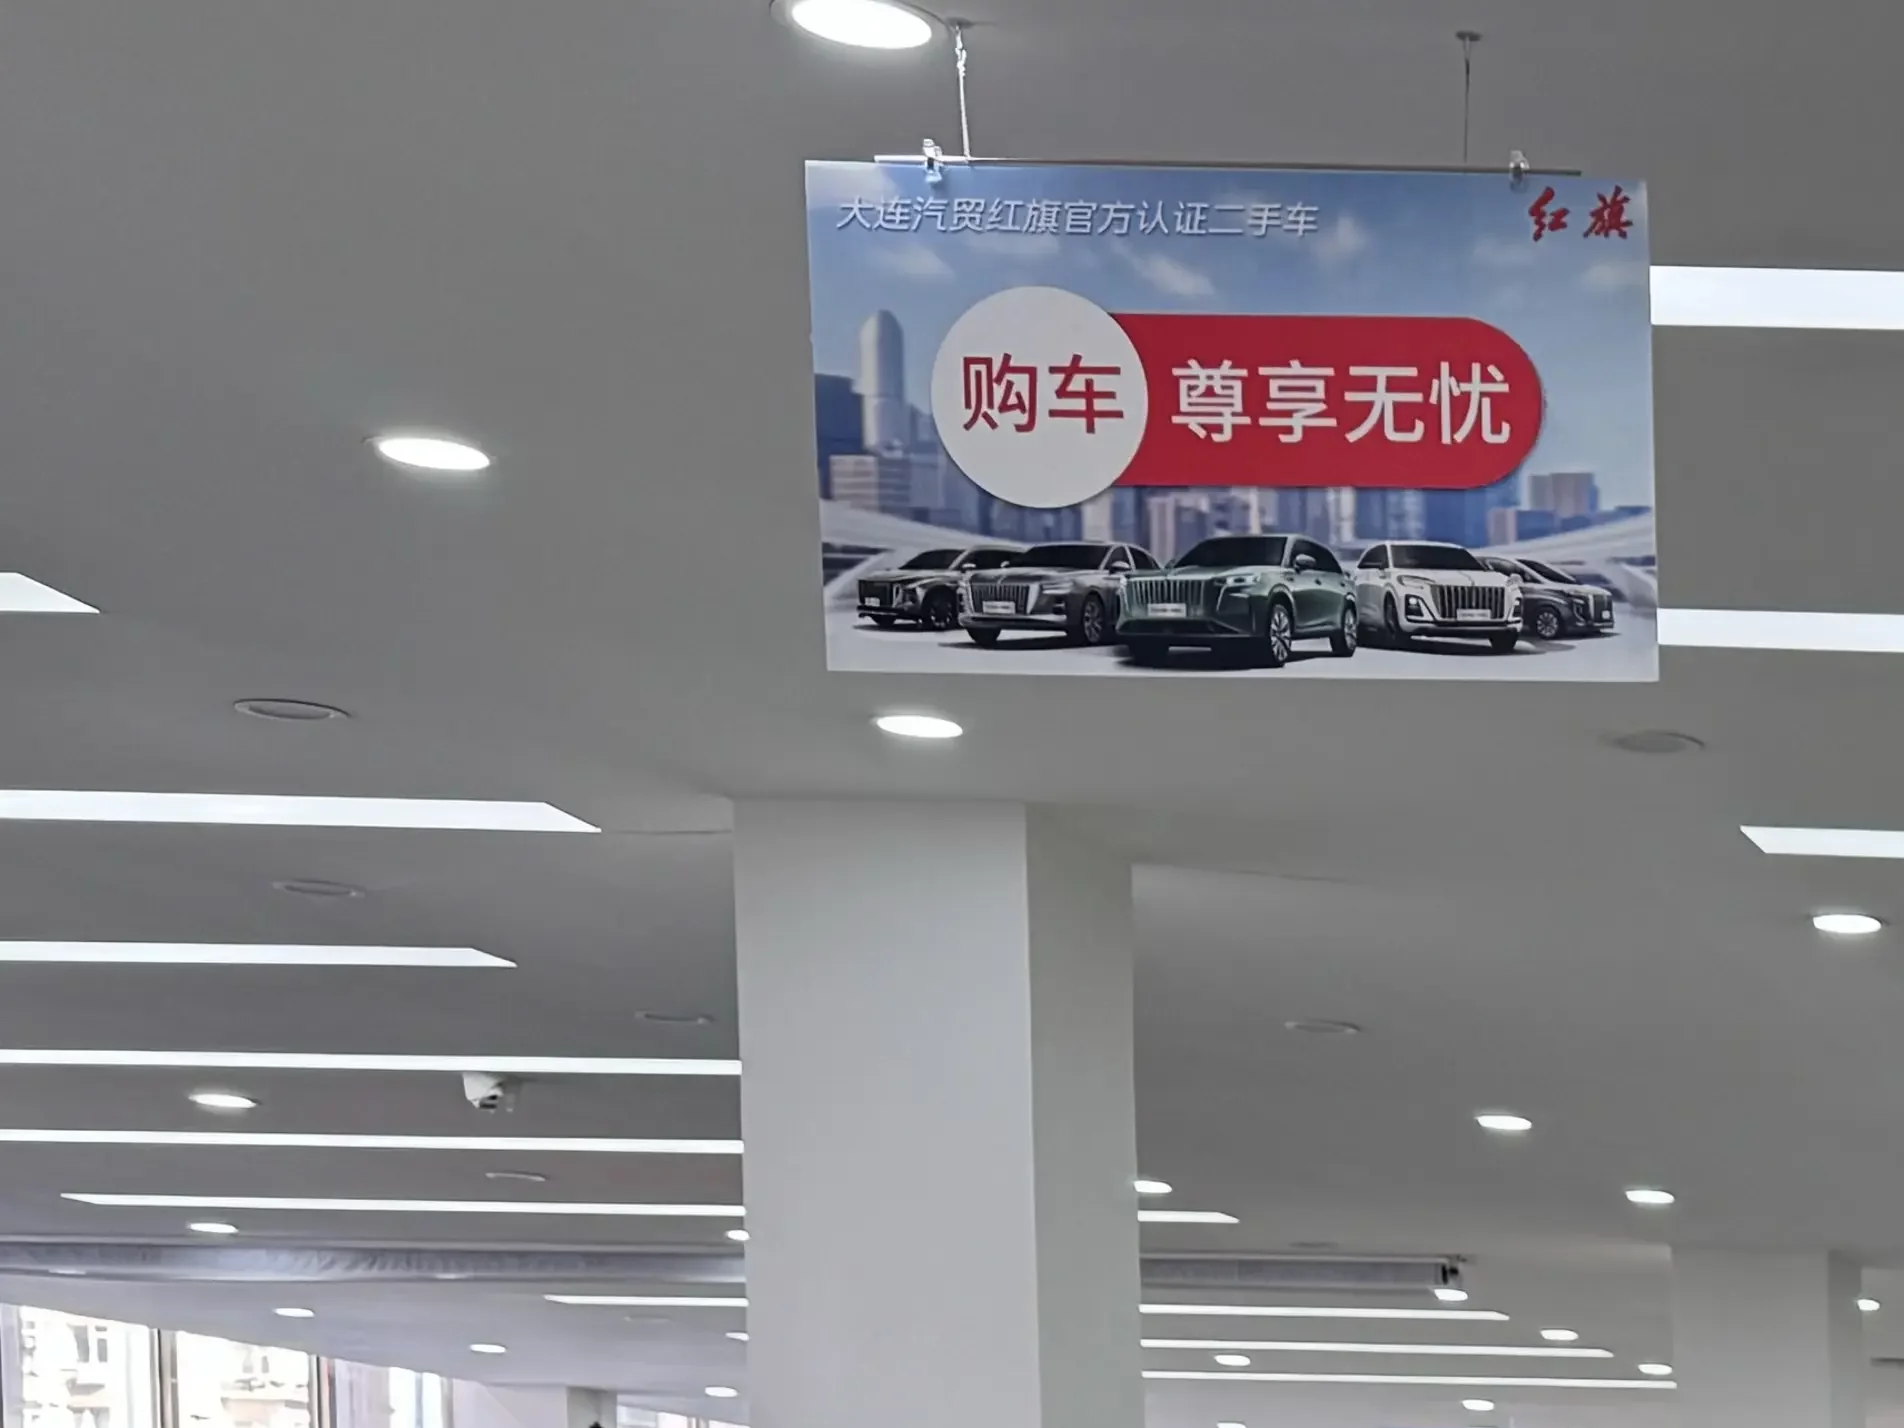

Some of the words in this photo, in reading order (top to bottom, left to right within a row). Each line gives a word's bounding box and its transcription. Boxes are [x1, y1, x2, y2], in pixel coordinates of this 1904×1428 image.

[835, 196, 1320, 237] 大连汽贸红旗官方认证二手车
[1528, 184, 1634, 242] 红旗
[962, 353, 1124, 434] 购车
[1171, 358, 1512, 445] 尊享无忧
